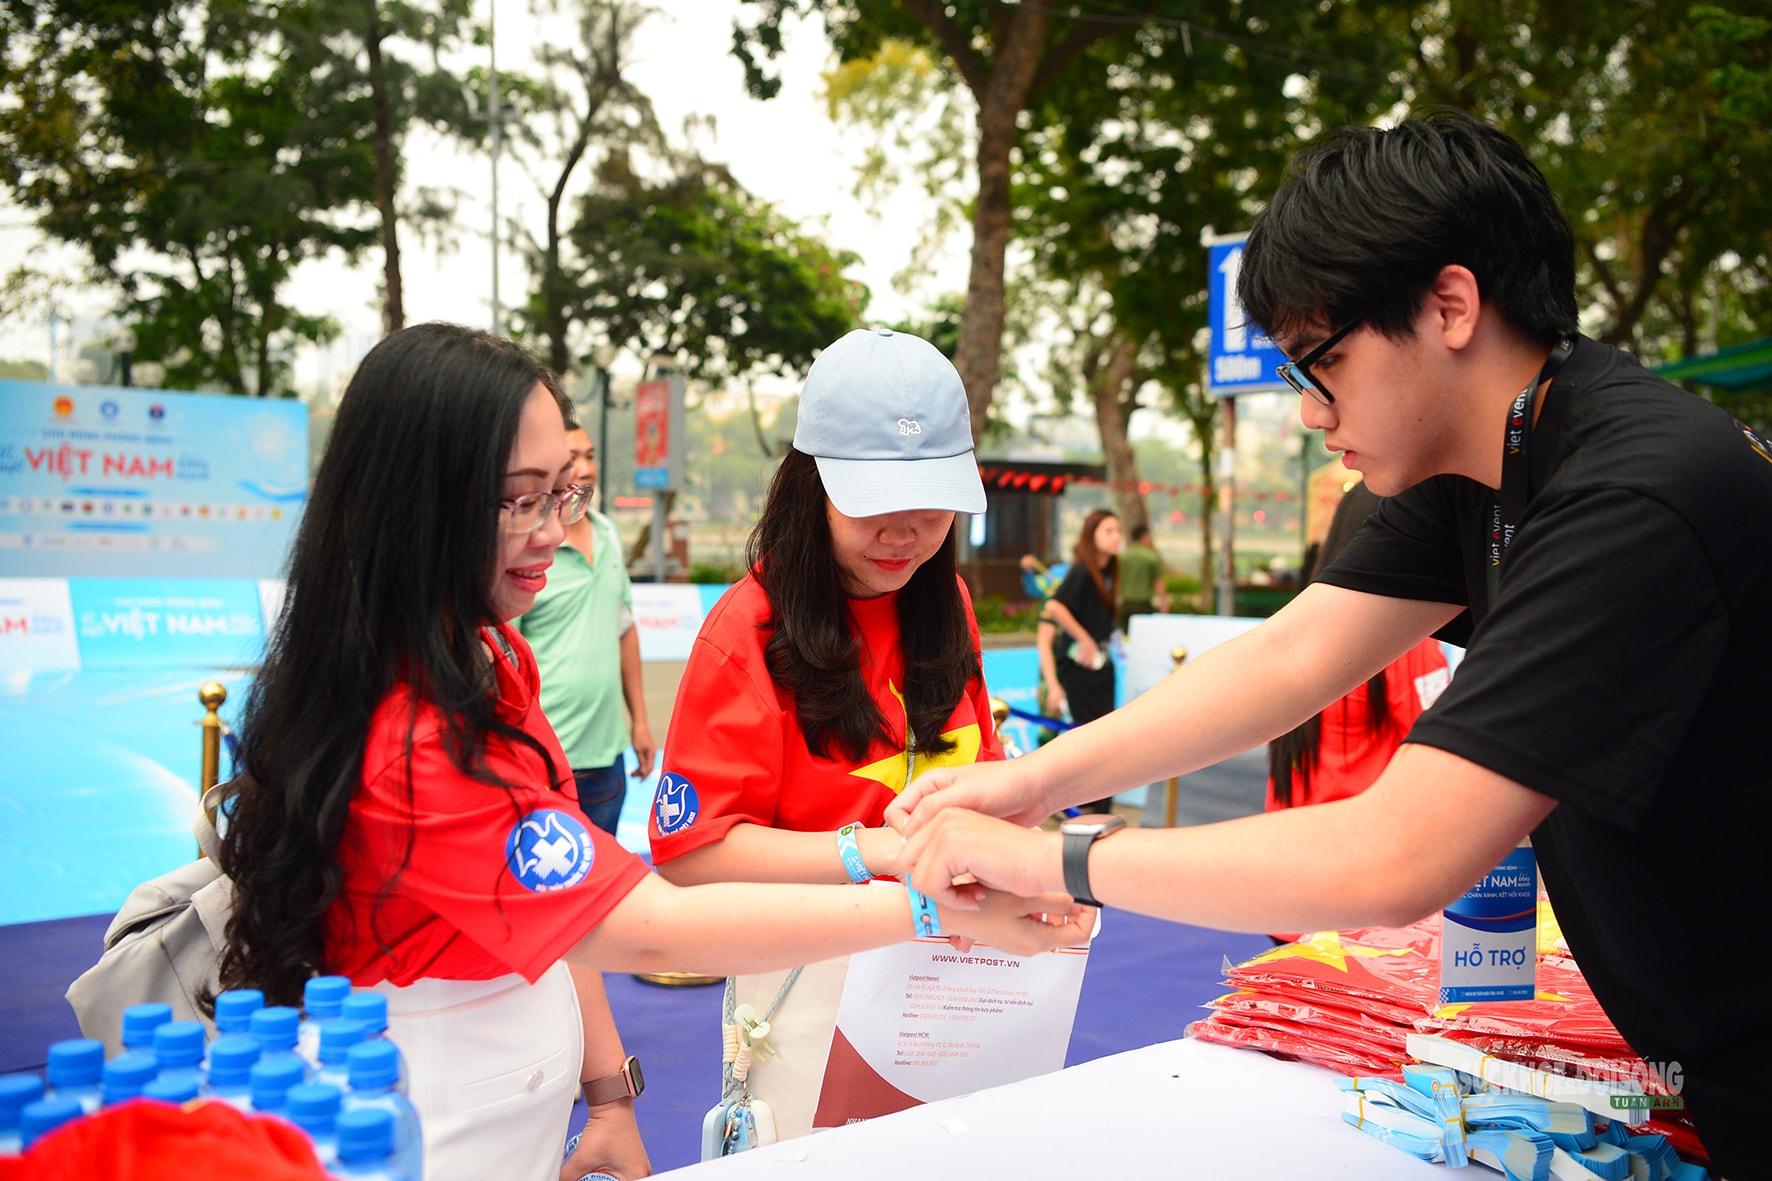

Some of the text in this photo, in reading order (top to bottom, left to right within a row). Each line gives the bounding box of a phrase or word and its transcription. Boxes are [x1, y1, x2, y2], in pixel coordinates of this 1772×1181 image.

[1214, 355, 1262, 384] 500m
[1507, 429, 1522, 455] viet
[25, 440, 93, 482] VIỆT
[103, 451, 174, 480] NAM
[1490, 504, 1501, 567] viet event
[102, 607, 161, 640] VIỆT
[166, 612, 228, 636] NAM
[1491, 875, 1518, 888] NAM
[931, 954, 1020, 968] WWW.VIETPOST.VN
[1454, 943, 1526, 970] HỖ TRỢ
